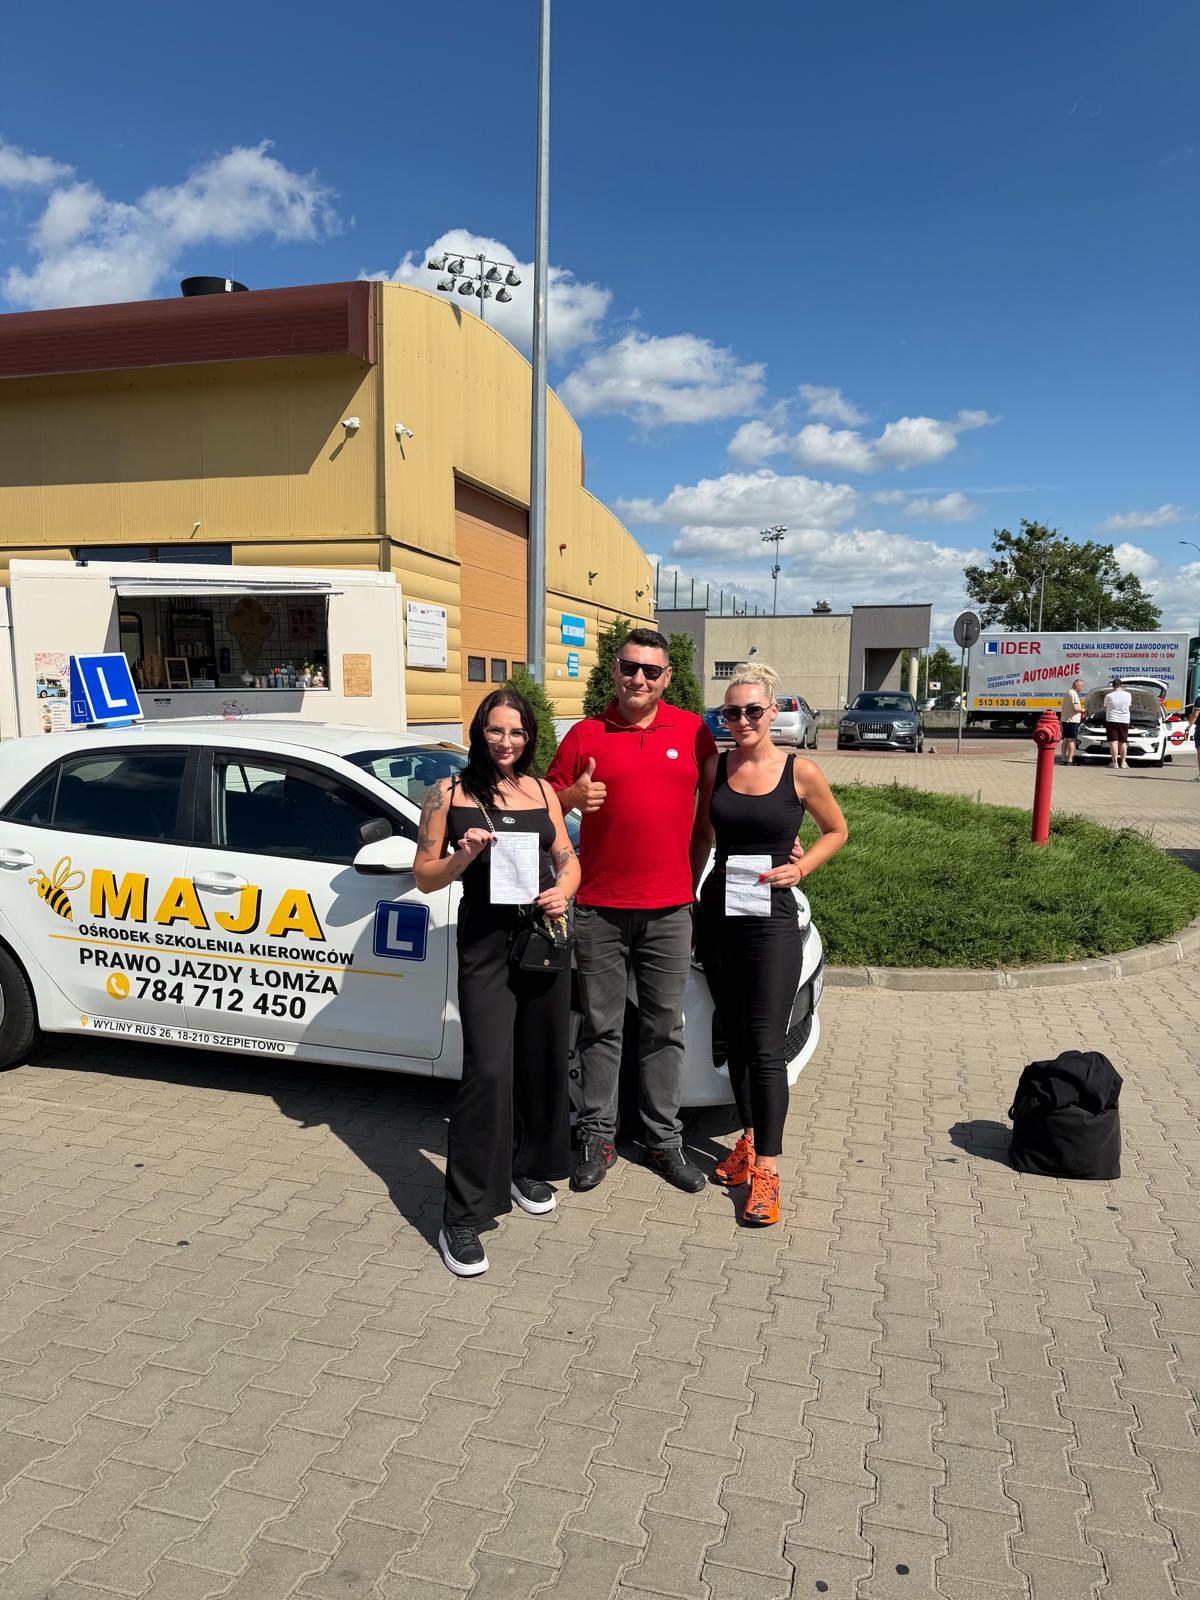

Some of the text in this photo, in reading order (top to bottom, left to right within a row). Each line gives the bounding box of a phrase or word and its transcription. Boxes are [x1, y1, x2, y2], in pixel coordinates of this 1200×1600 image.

[984, 641, 1041, 655] LIDER
[1096, 642, 1133, 650] KIEROWCÓW
[96, 667, 128, 708] L
[1022, 663, 1080, 683] AUTOMACIE
[77, 703, 84, 714] L
[90, 868, 326, 942] MAJA
[79, 922, 355, 965] OŚRODEK SZKOLENIA KIEROWCÓW
[387, 910, 413, 951] L
[80, 947, 339, 996] PRAWO JAZDY ŁOMŻA
[135, 976, 306, 1019] 784 712 450
[93, 1019, 133, 1033] WYLINY
[159, 1028, 174, 1040] 26,
[177, 1031, 210, 1044] 18-210
[213, 1035, 286, 1052] SZEPIETOWO
